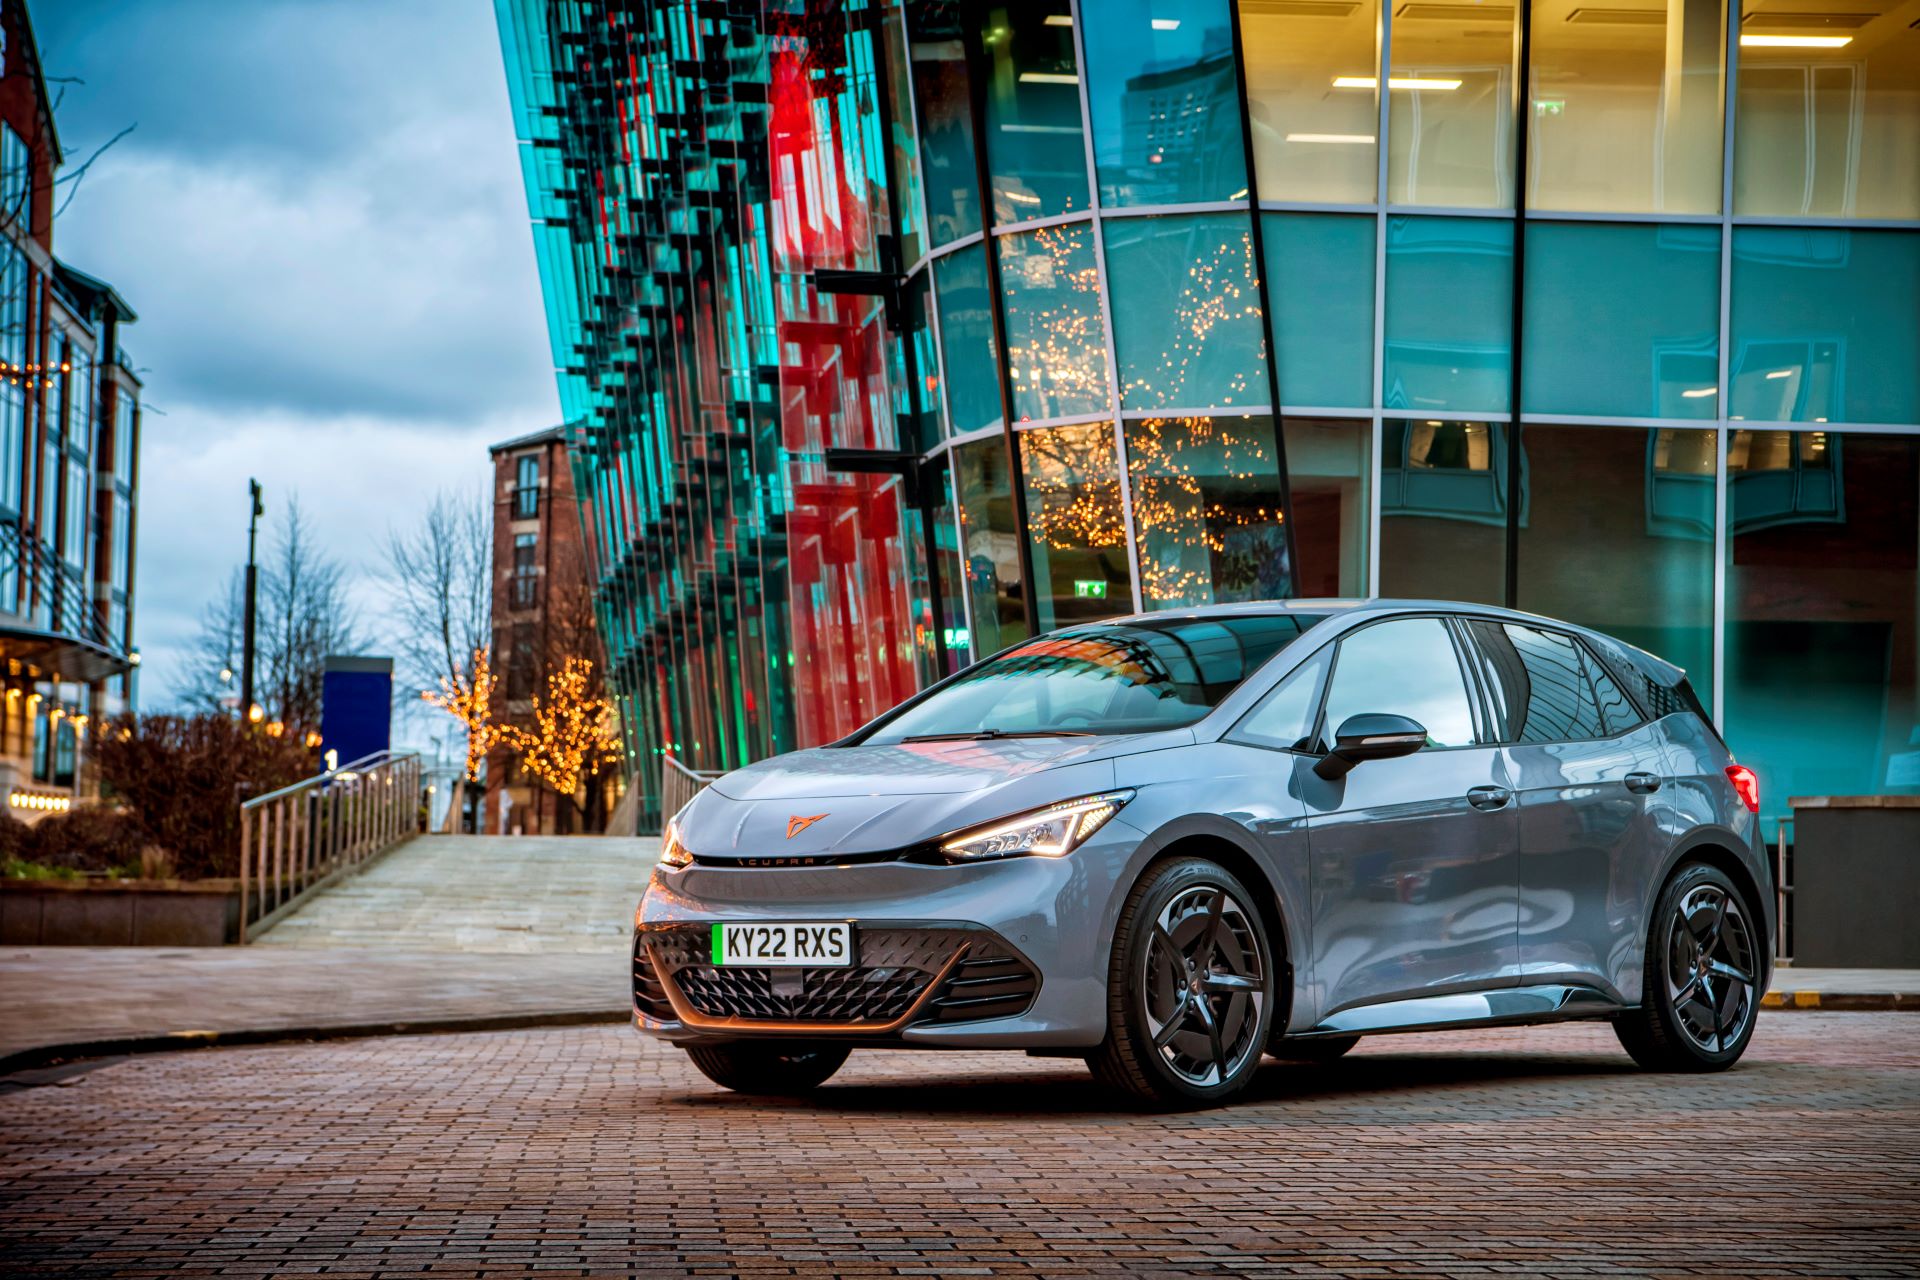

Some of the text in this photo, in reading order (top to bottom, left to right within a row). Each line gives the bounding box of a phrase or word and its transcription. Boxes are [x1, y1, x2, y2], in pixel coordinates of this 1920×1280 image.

[748, 857, 814, 866] CUPRA
[728, 928, 843, 957] KY22 RXS
